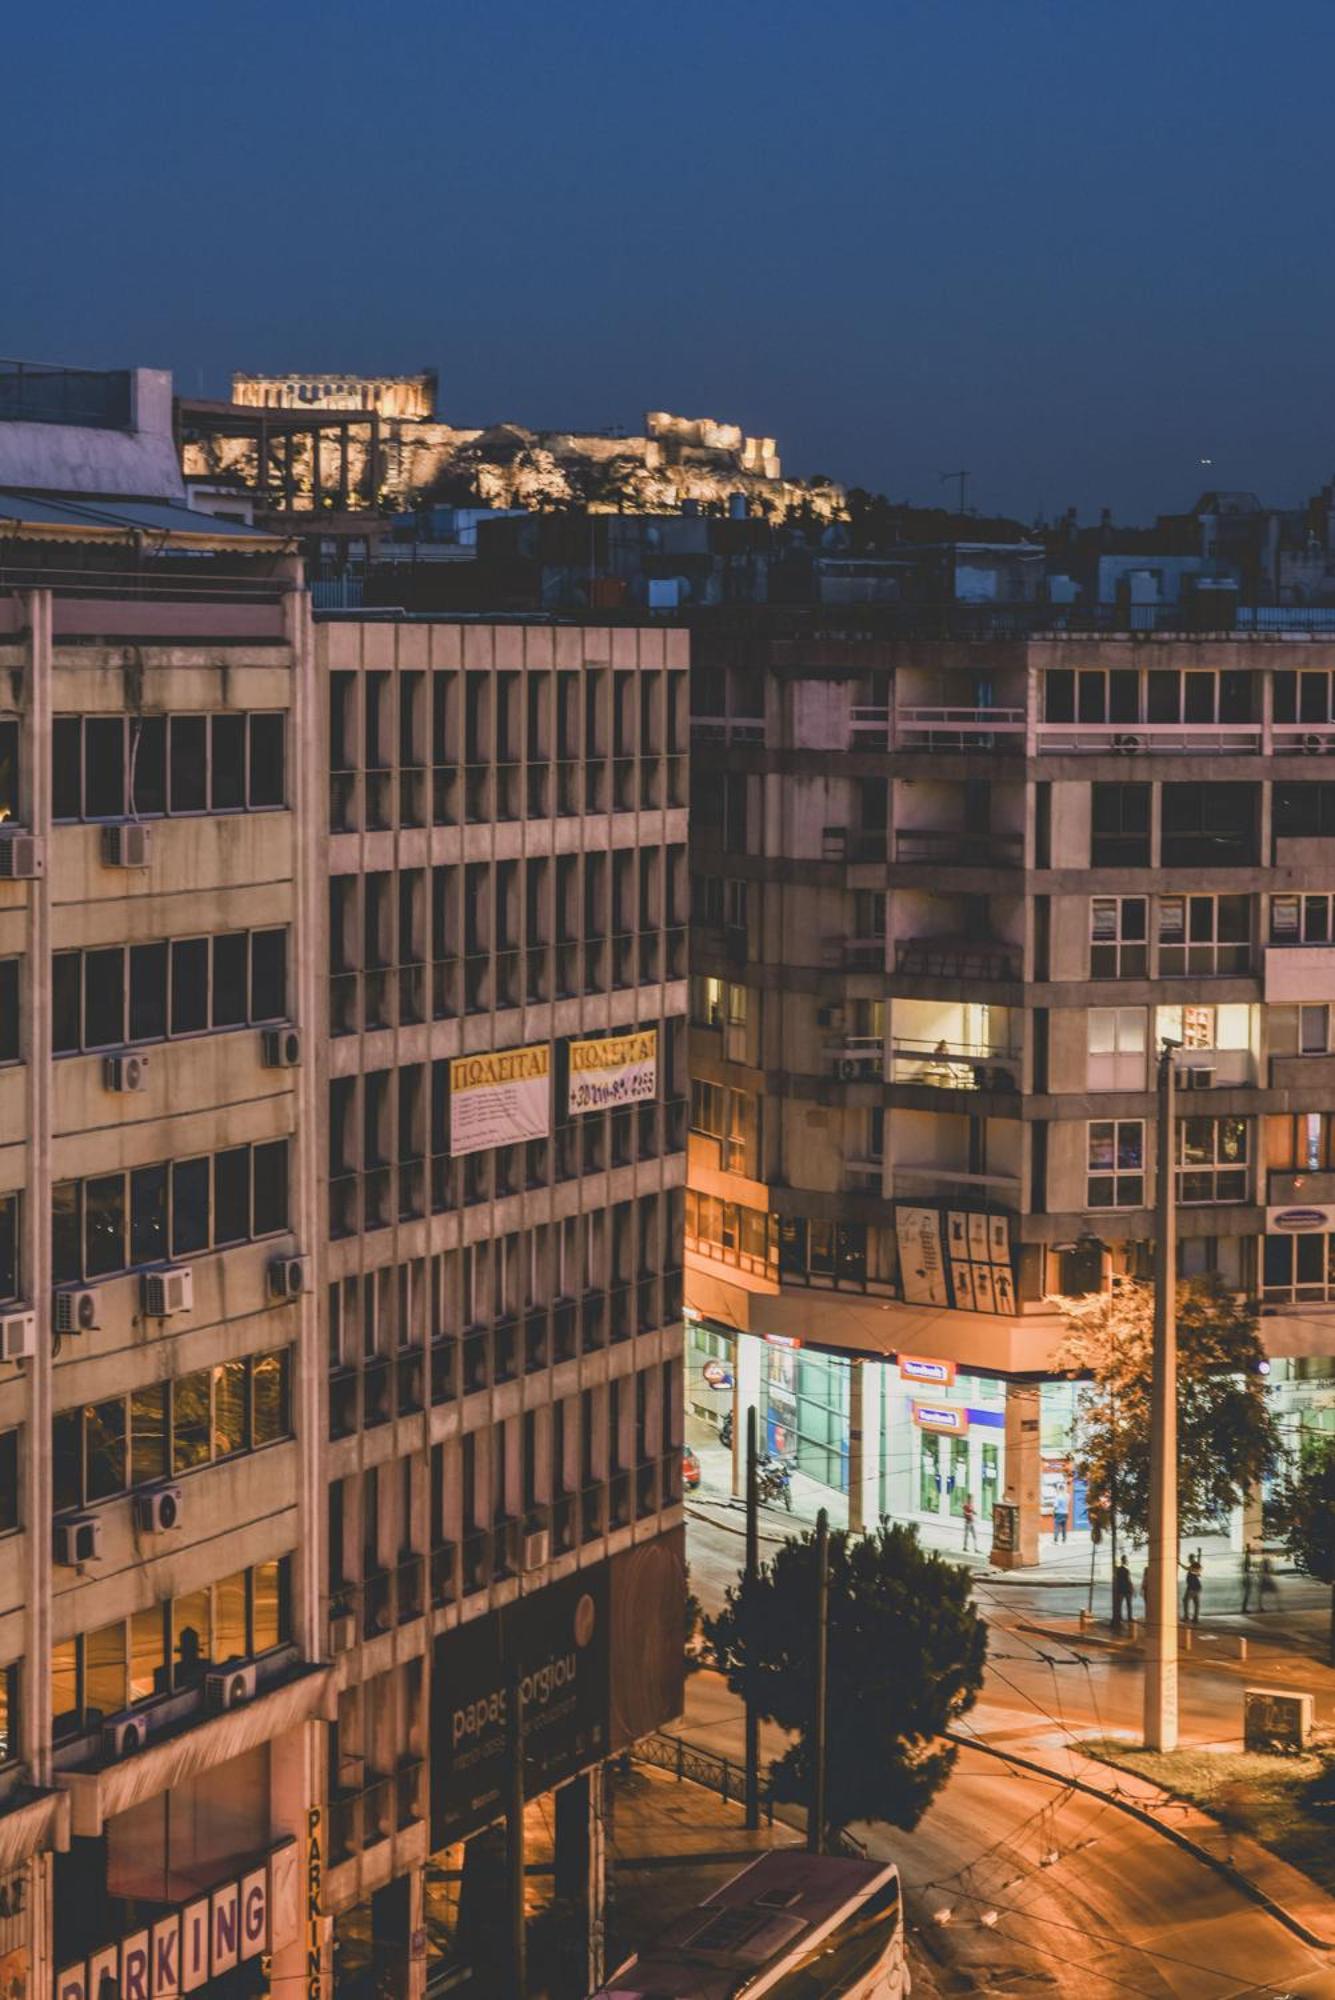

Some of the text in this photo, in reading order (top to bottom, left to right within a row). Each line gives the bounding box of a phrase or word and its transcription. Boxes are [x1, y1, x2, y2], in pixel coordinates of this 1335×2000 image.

[454, 1049, 547, 1090] ΠΩΛΕΙΤΑΙ
[452, 1653, 577, 1749] papagorgiou
[62, 1886, 265, 2000] RKING
[307, 1809, 321, 2000] PARKING
